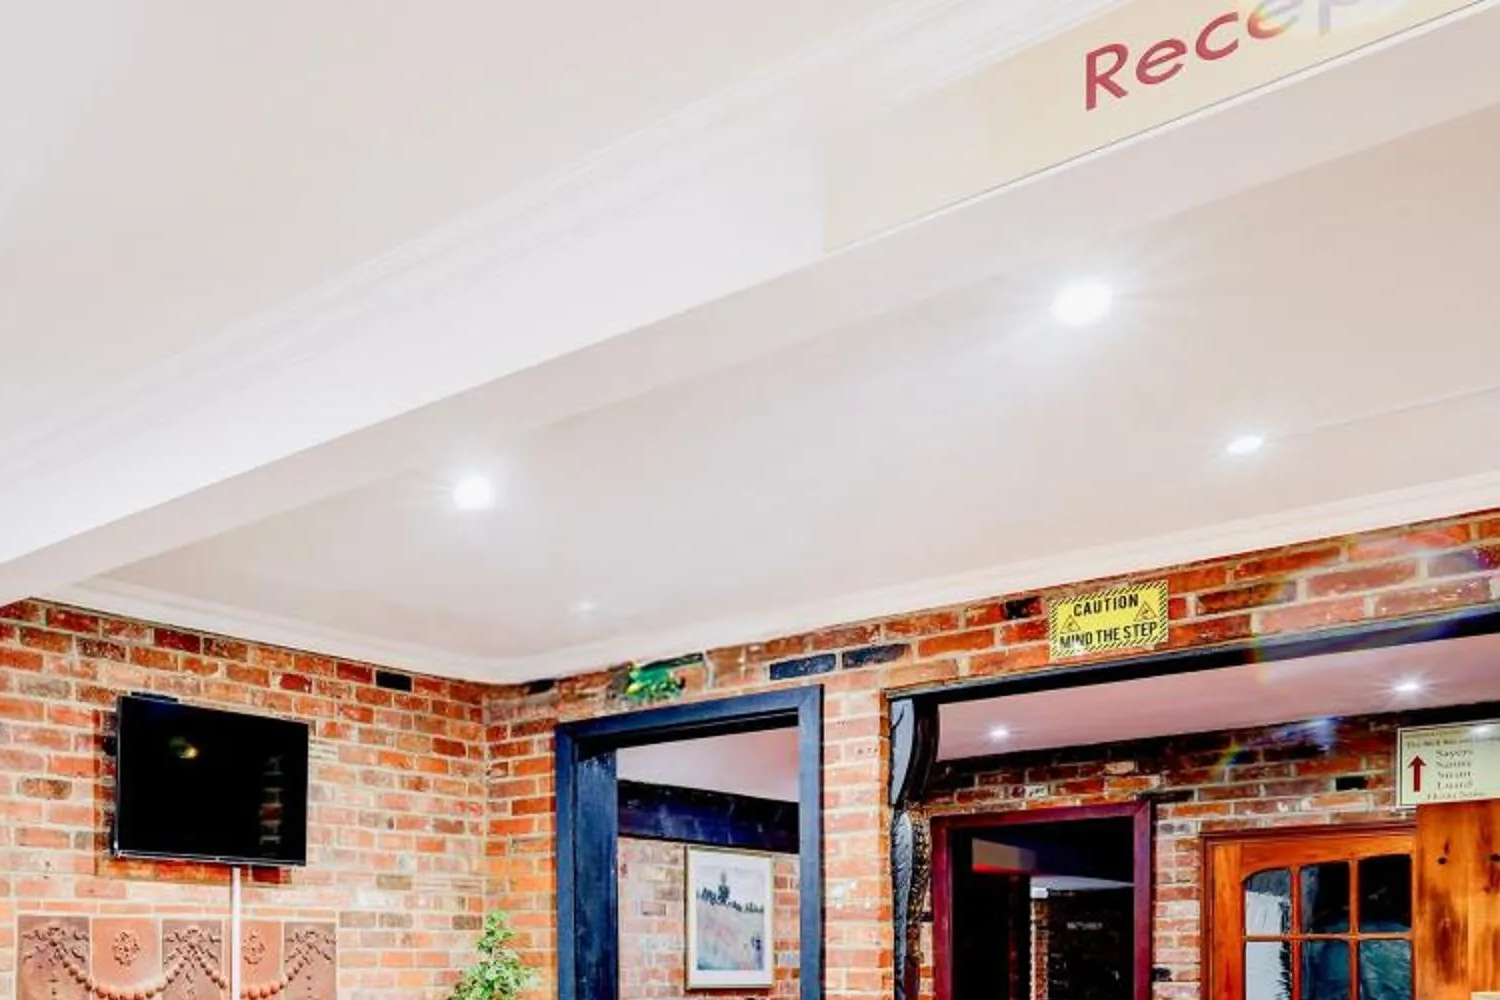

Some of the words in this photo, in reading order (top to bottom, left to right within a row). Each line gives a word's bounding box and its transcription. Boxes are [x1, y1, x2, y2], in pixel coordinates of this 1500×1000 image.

[1073, 594, 1138, 617] CAUTION
[1060, 631, 1093, 648] MIND
[1096, 627, 1120, 642] THE
[1123, 621, 1157, 639] STEP
